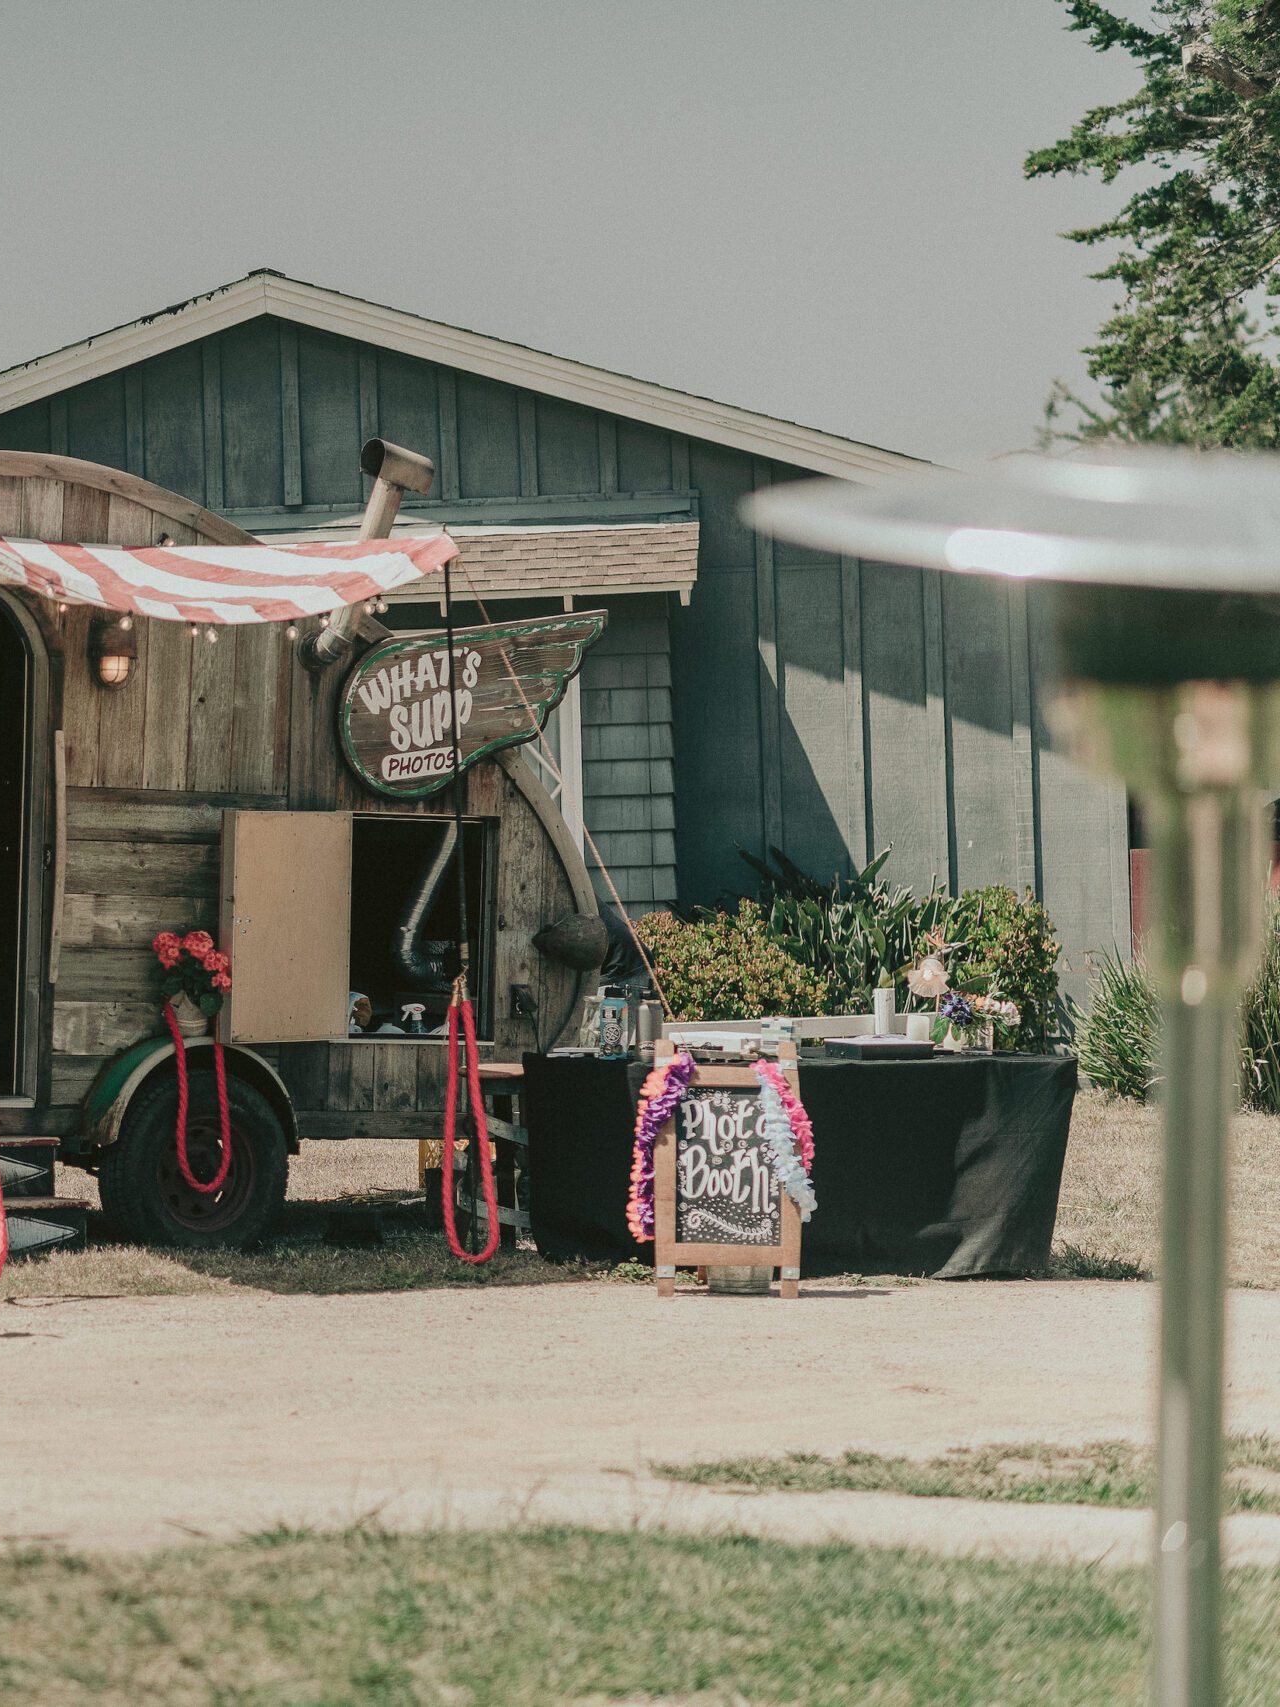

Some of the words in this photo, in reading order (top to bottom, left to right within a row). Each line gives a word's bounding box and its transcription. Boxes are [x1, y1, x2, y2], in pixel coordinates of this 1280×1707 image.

[359, 647, 482, 715] WHAT'S
[389, 689, 473, 751] SUPP
[388, 751, 457, 778] PHOTOS
[680, 1145, 776, 1213] Booth
